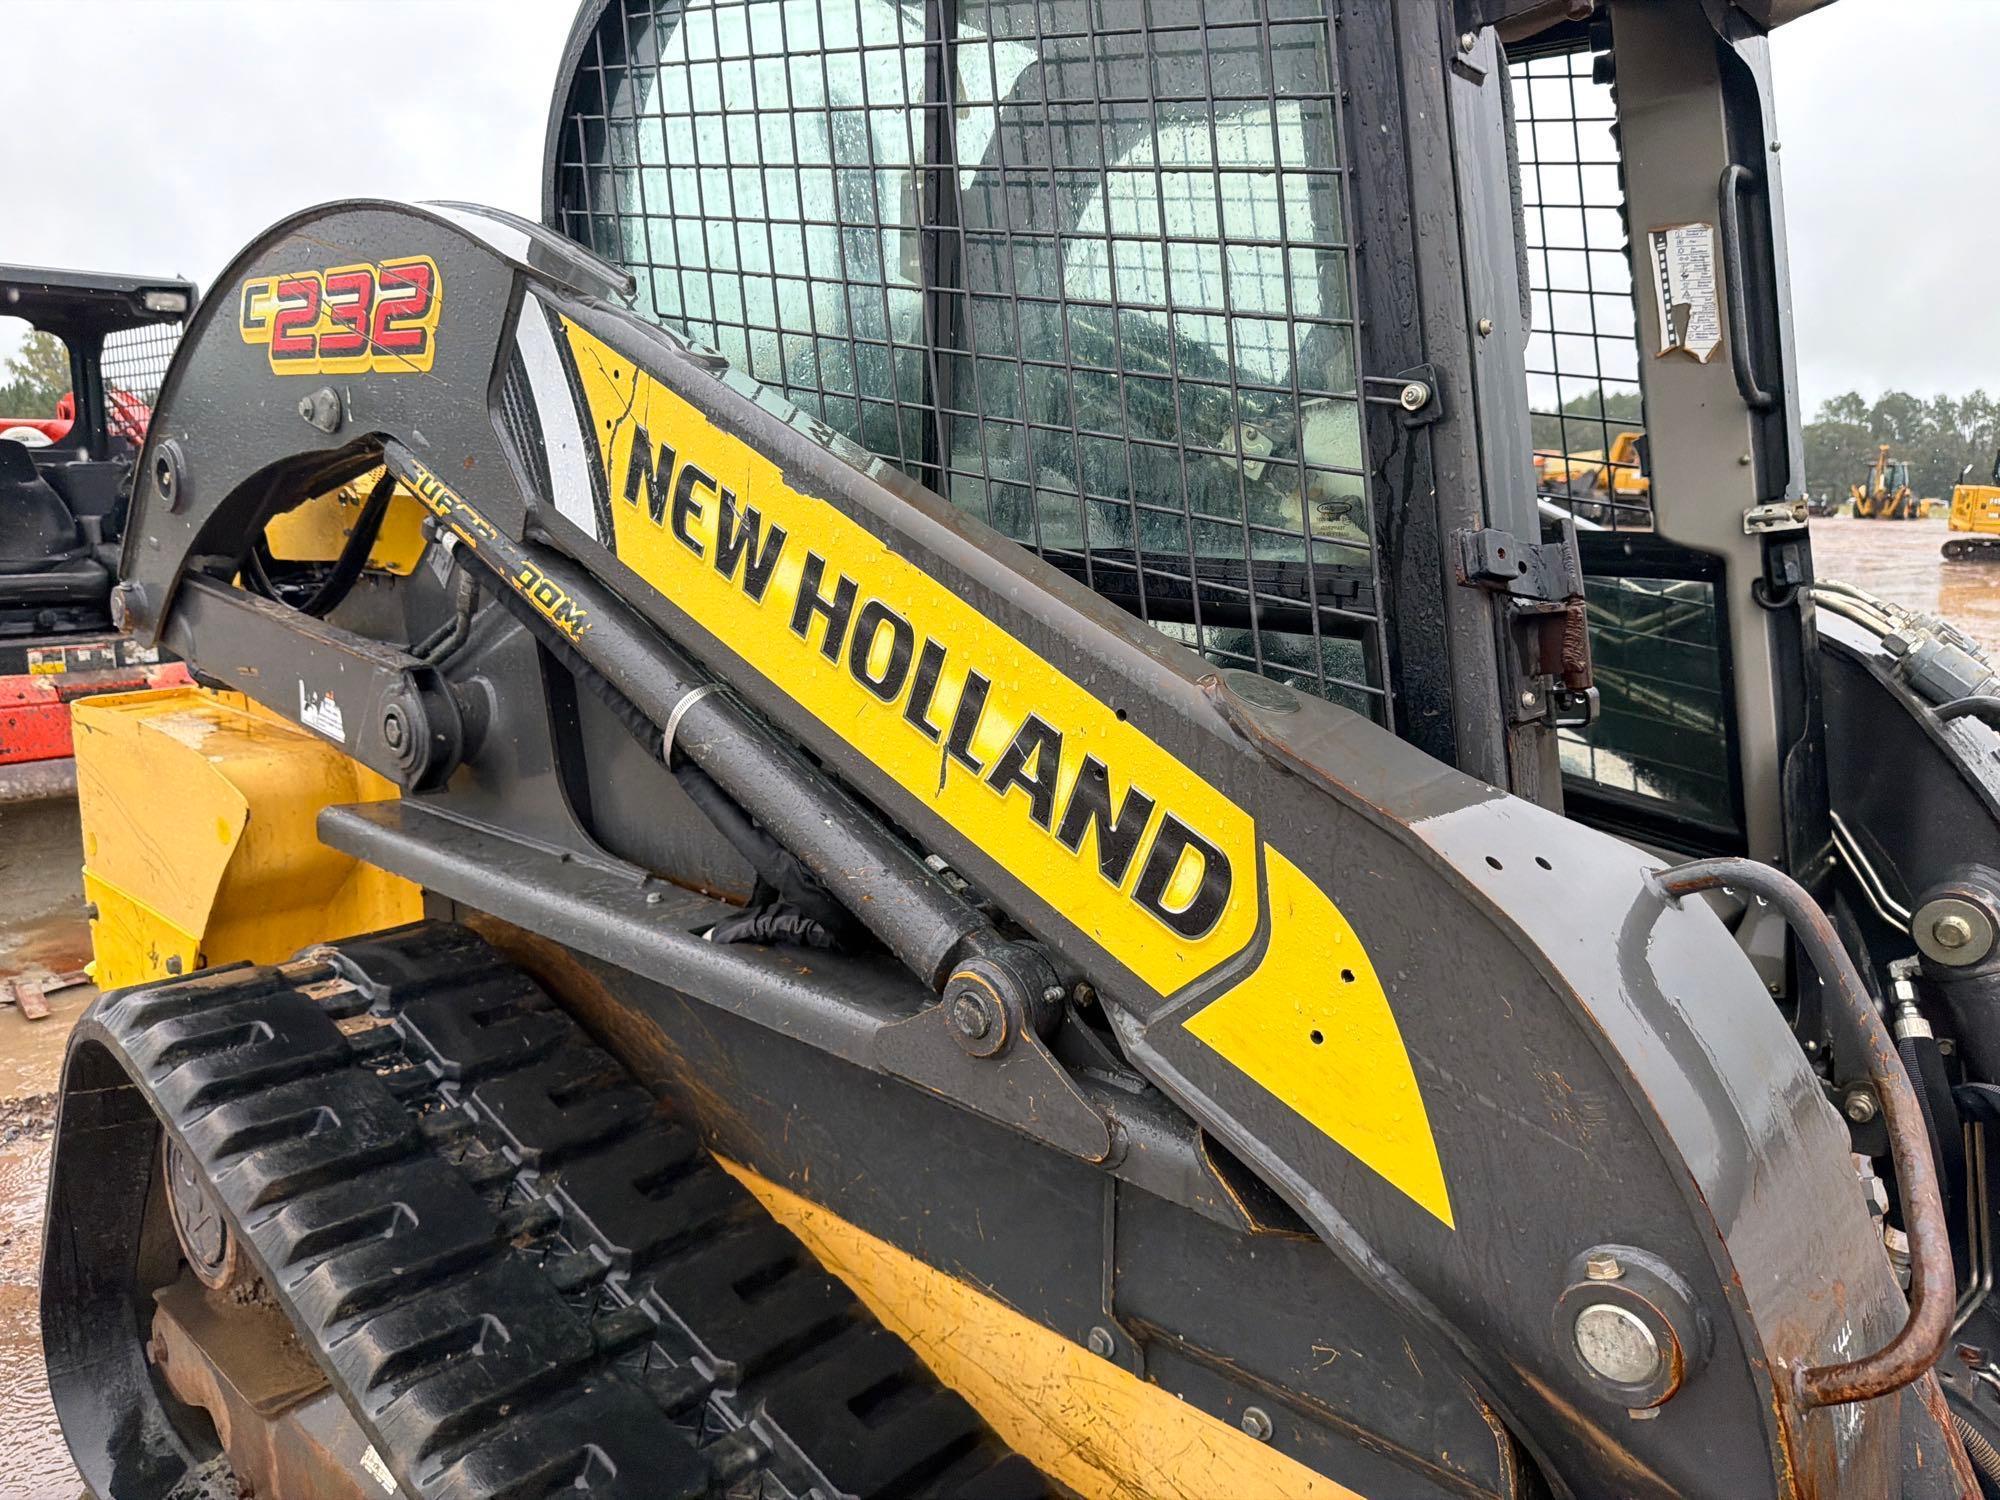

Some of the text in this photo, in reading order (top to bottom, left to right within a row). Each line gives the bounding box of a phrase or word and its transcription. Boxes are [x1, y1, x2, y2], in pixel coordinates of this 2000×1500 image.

[241, 257, 439, 370] C232
[623, 424, 1234, 942] NEW HOLLAND
